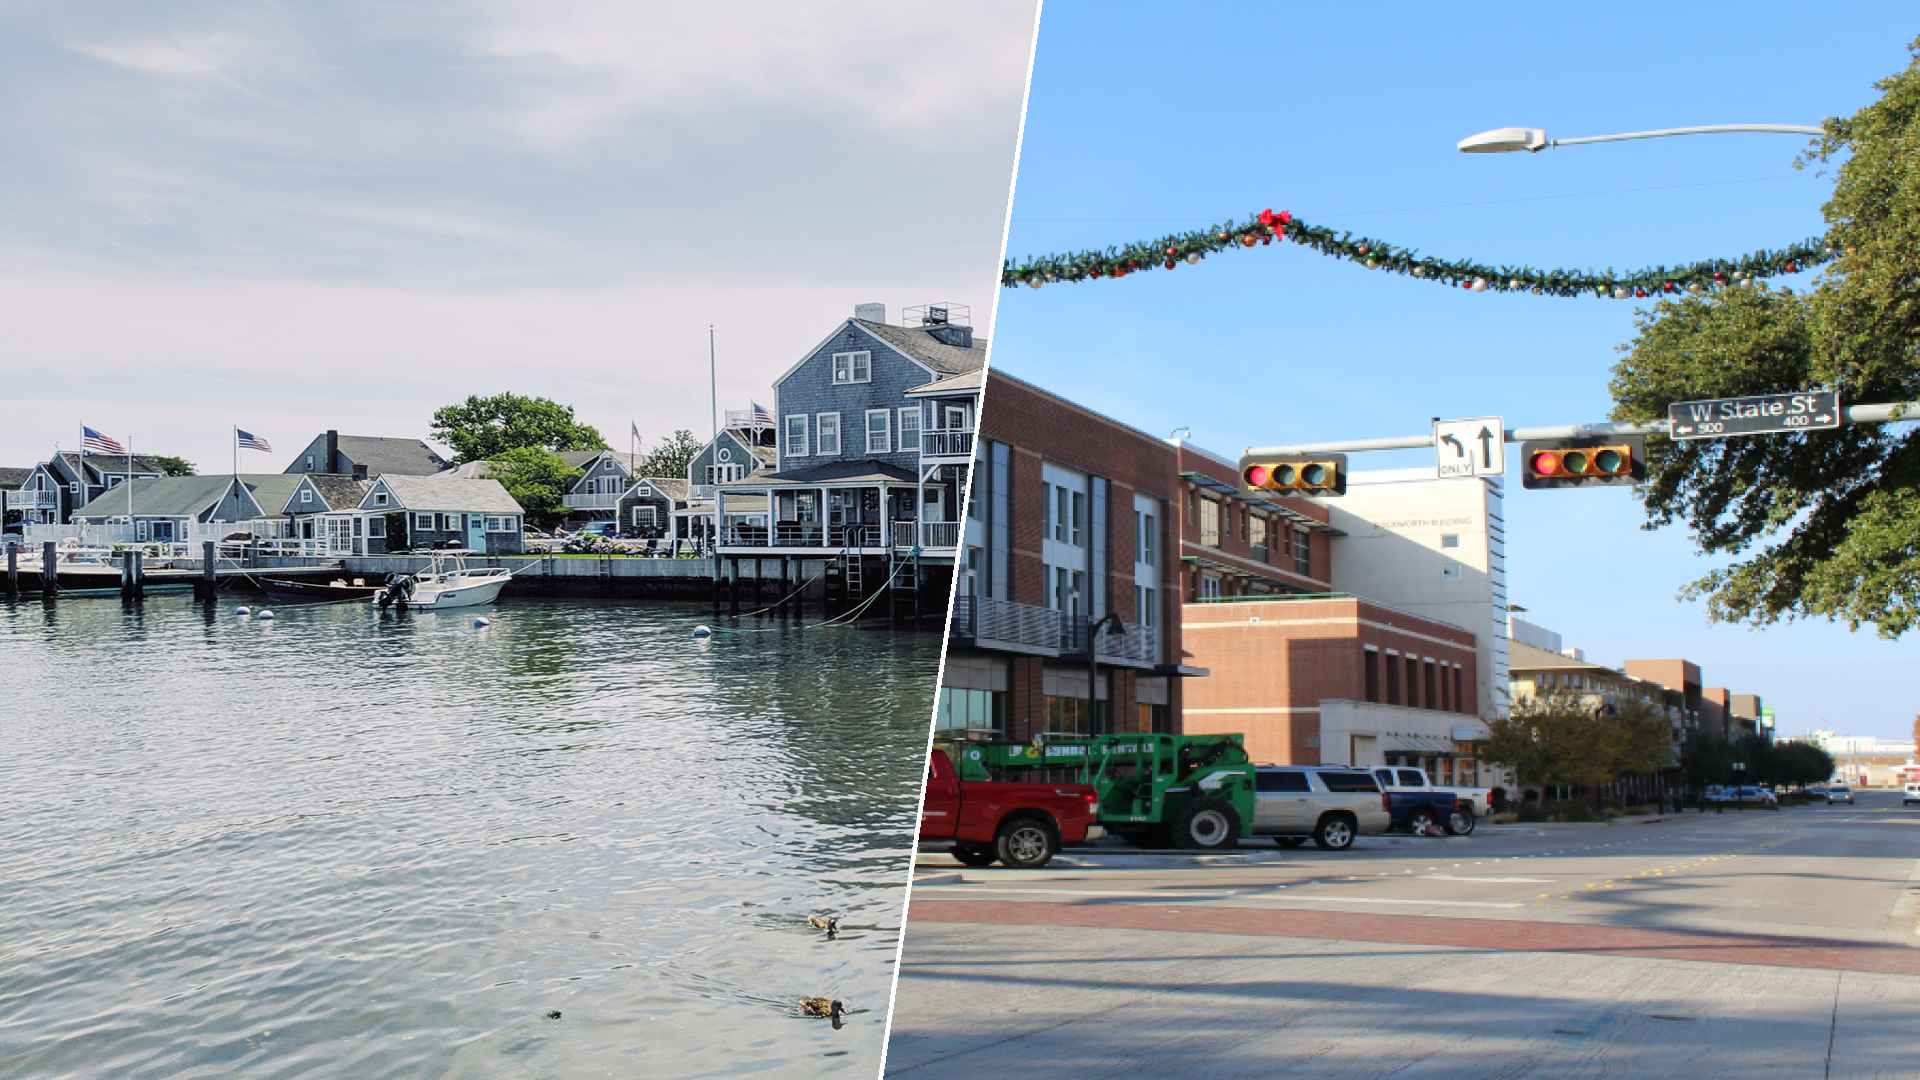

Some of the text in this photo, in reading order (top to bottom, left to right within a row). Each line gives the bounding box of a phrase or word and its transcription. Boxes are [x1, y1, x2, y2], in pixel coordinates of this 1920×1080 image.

[1689, 394, 1818, 422] W State St
[1440, 463, 1472, 475] ONLY
